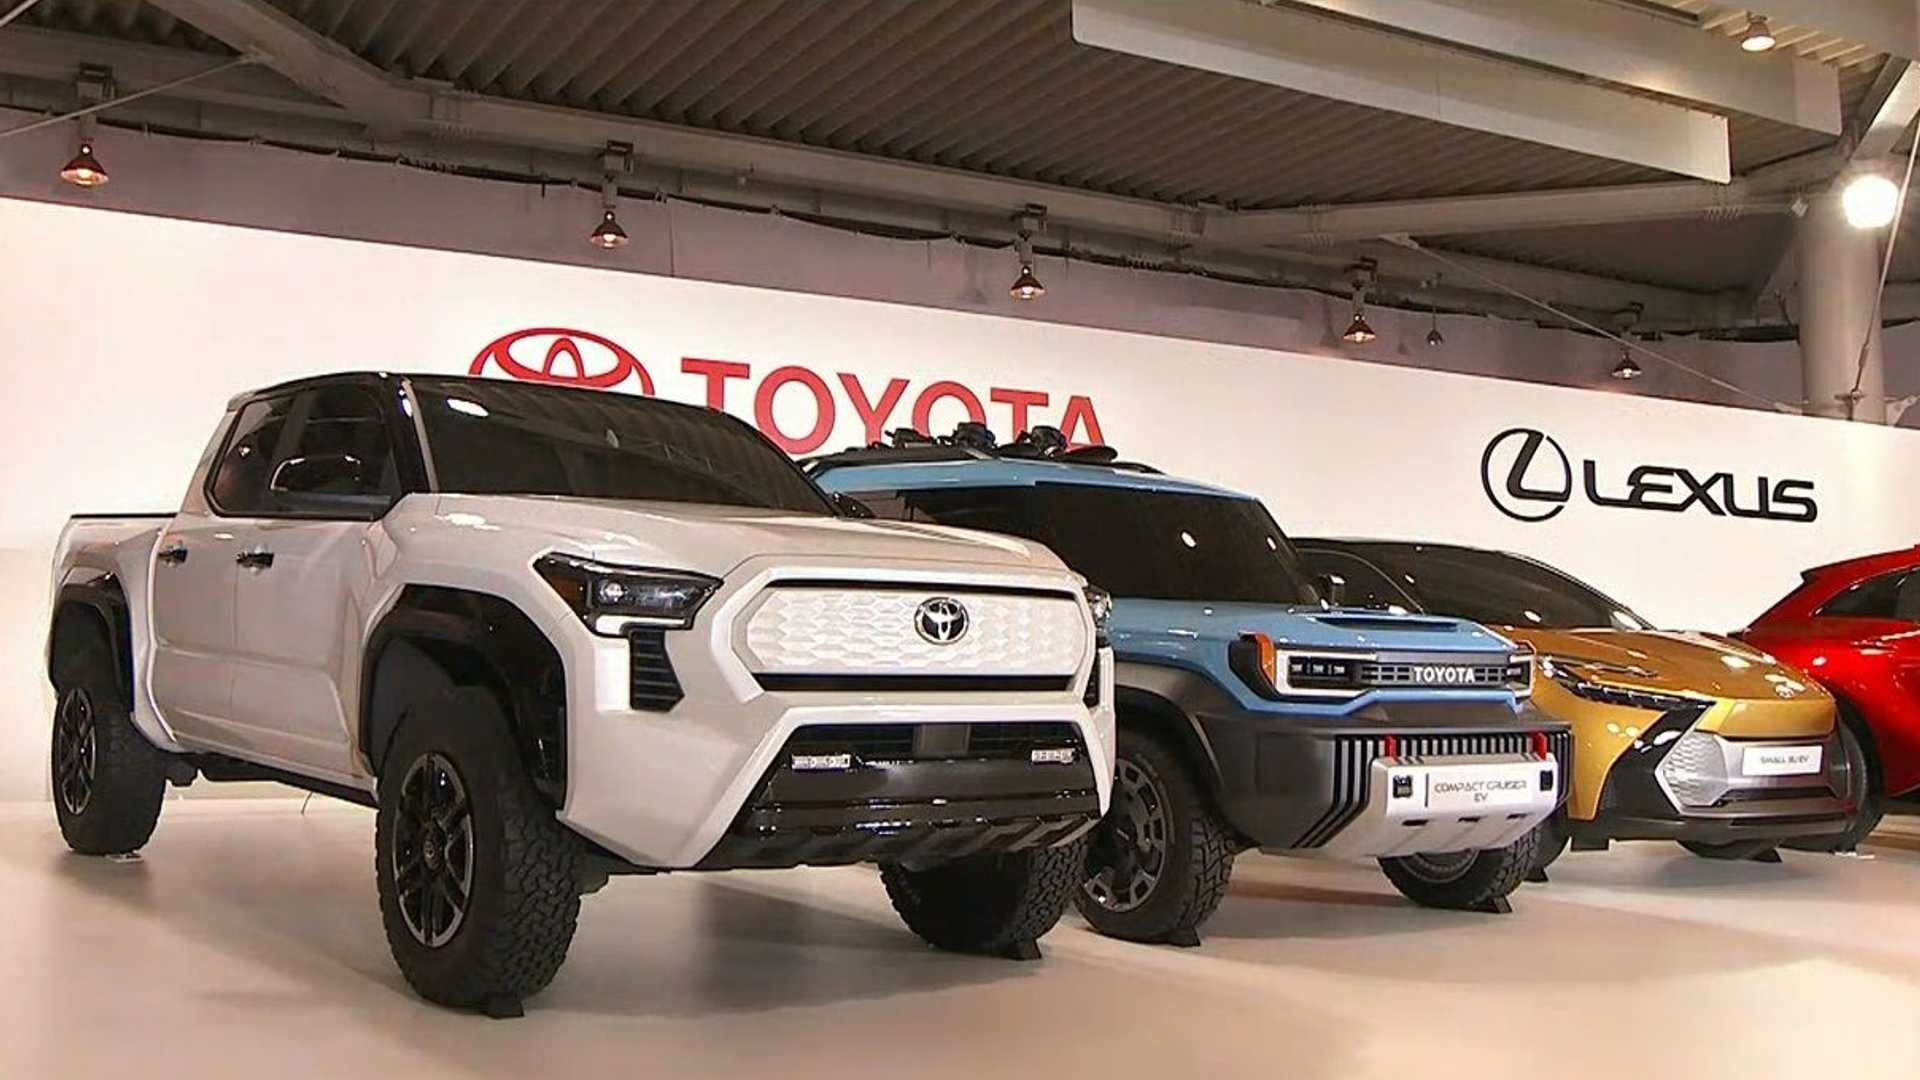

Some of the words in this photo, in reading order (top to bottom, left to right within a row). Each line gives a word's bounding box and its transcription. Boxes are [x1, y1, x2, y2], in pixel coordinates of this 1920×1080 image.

[681, 356, 1106, 455] TOYOTA
[1583, 459, 1818, 523] LEXUS
[1413, 665, 1475, 683] TOYOTA
[1434, 781, 1484, 793] COMPACT
[1474, 793, 1488, 803] EV
